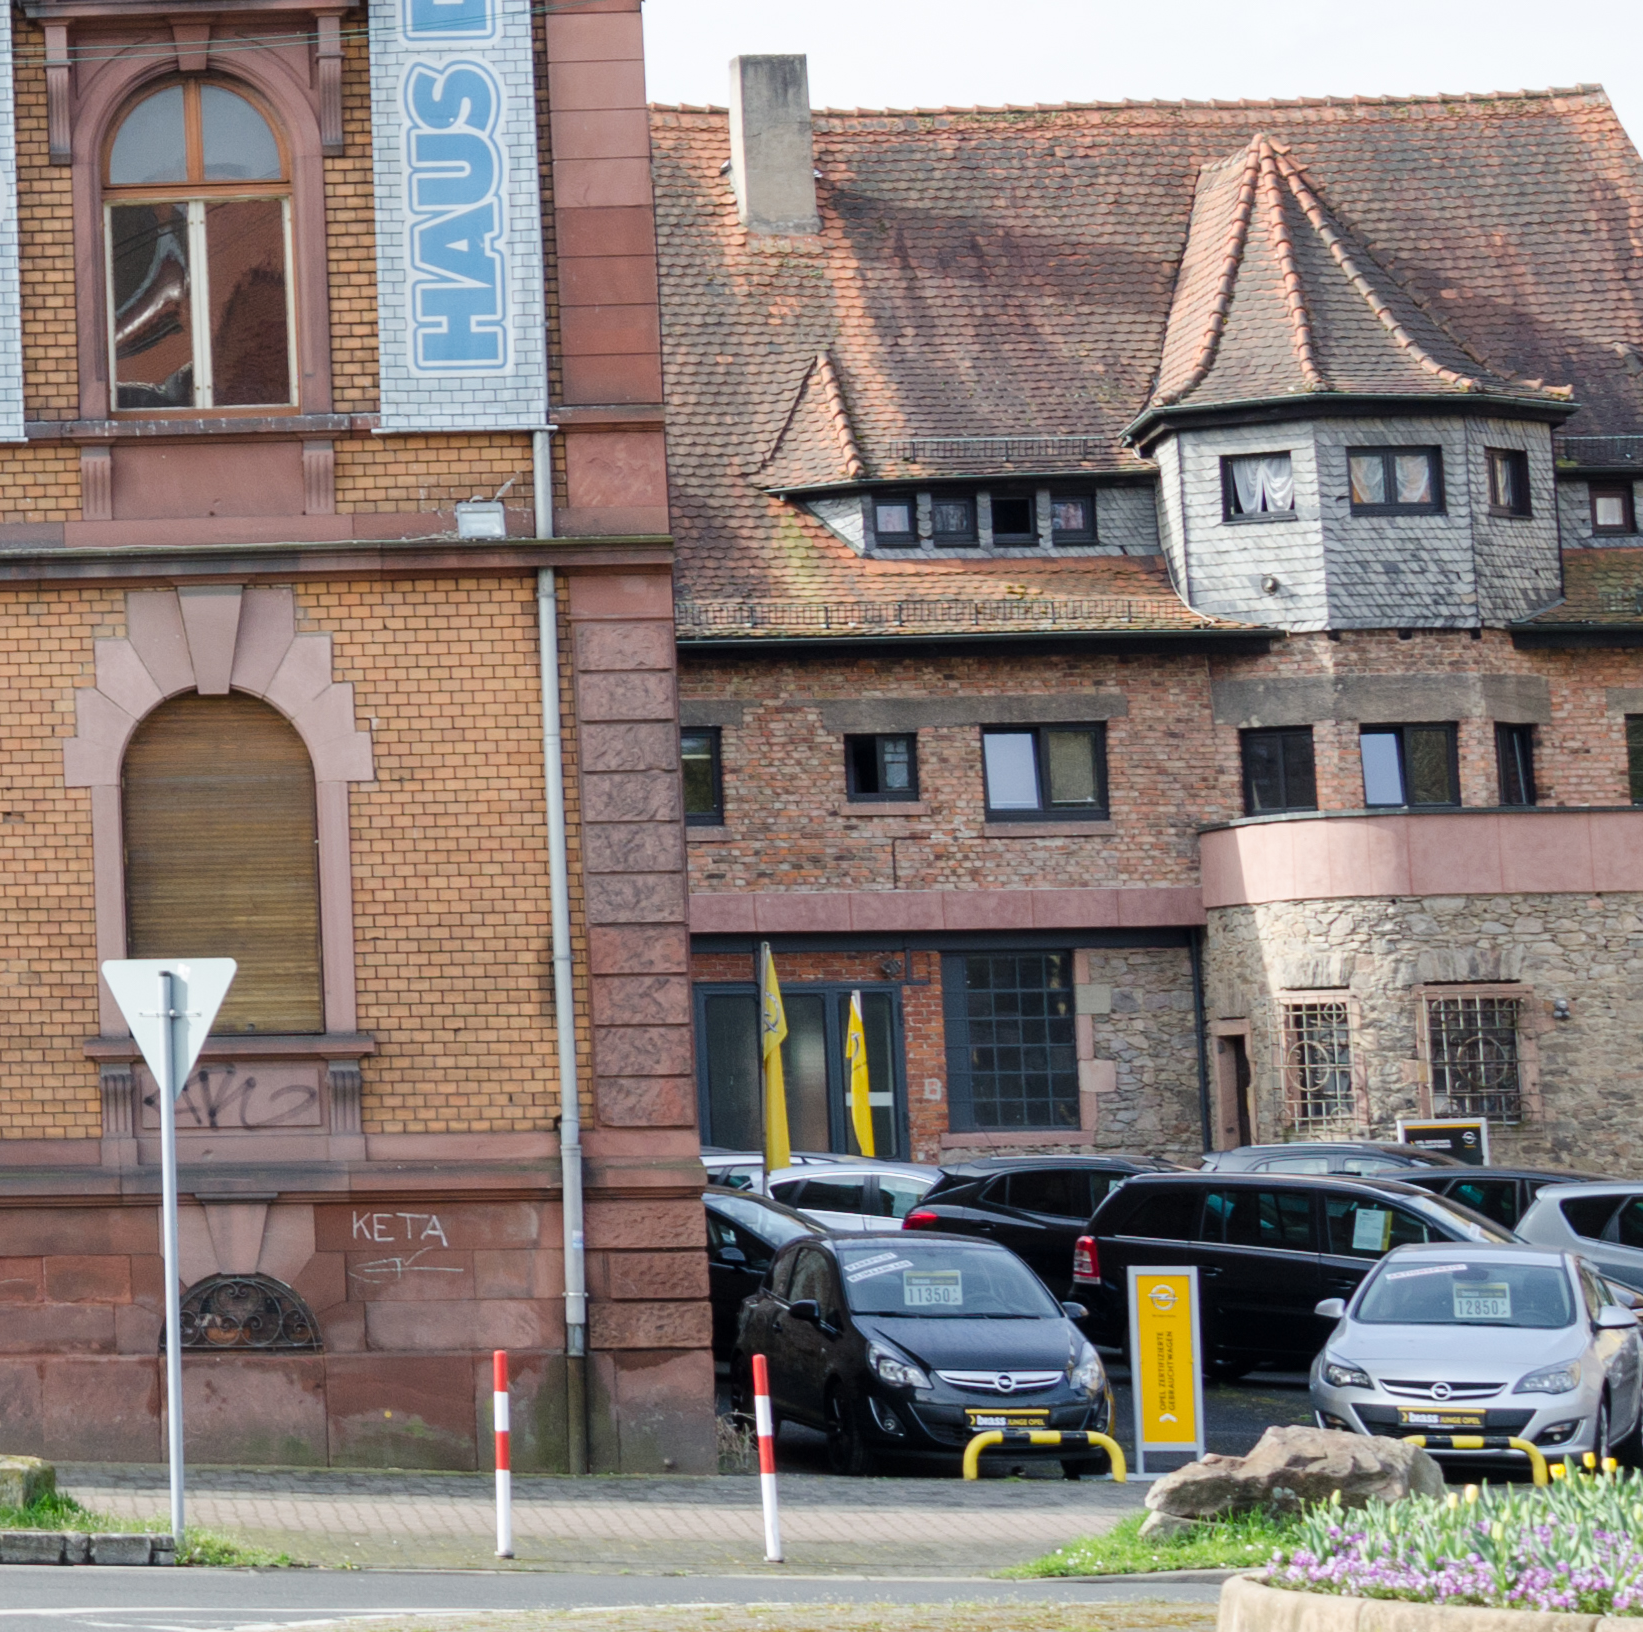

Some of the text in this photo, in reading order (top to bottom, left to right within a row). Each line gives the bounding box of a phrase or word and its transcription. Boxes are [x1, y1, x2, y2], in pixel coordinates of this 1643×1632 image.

[401, 59, 511, 372] HAUS
[353, 1211, 448, 1247] KETA
[1166, 1331, 1176, 1411] GEBRAUCHTWAGEN
